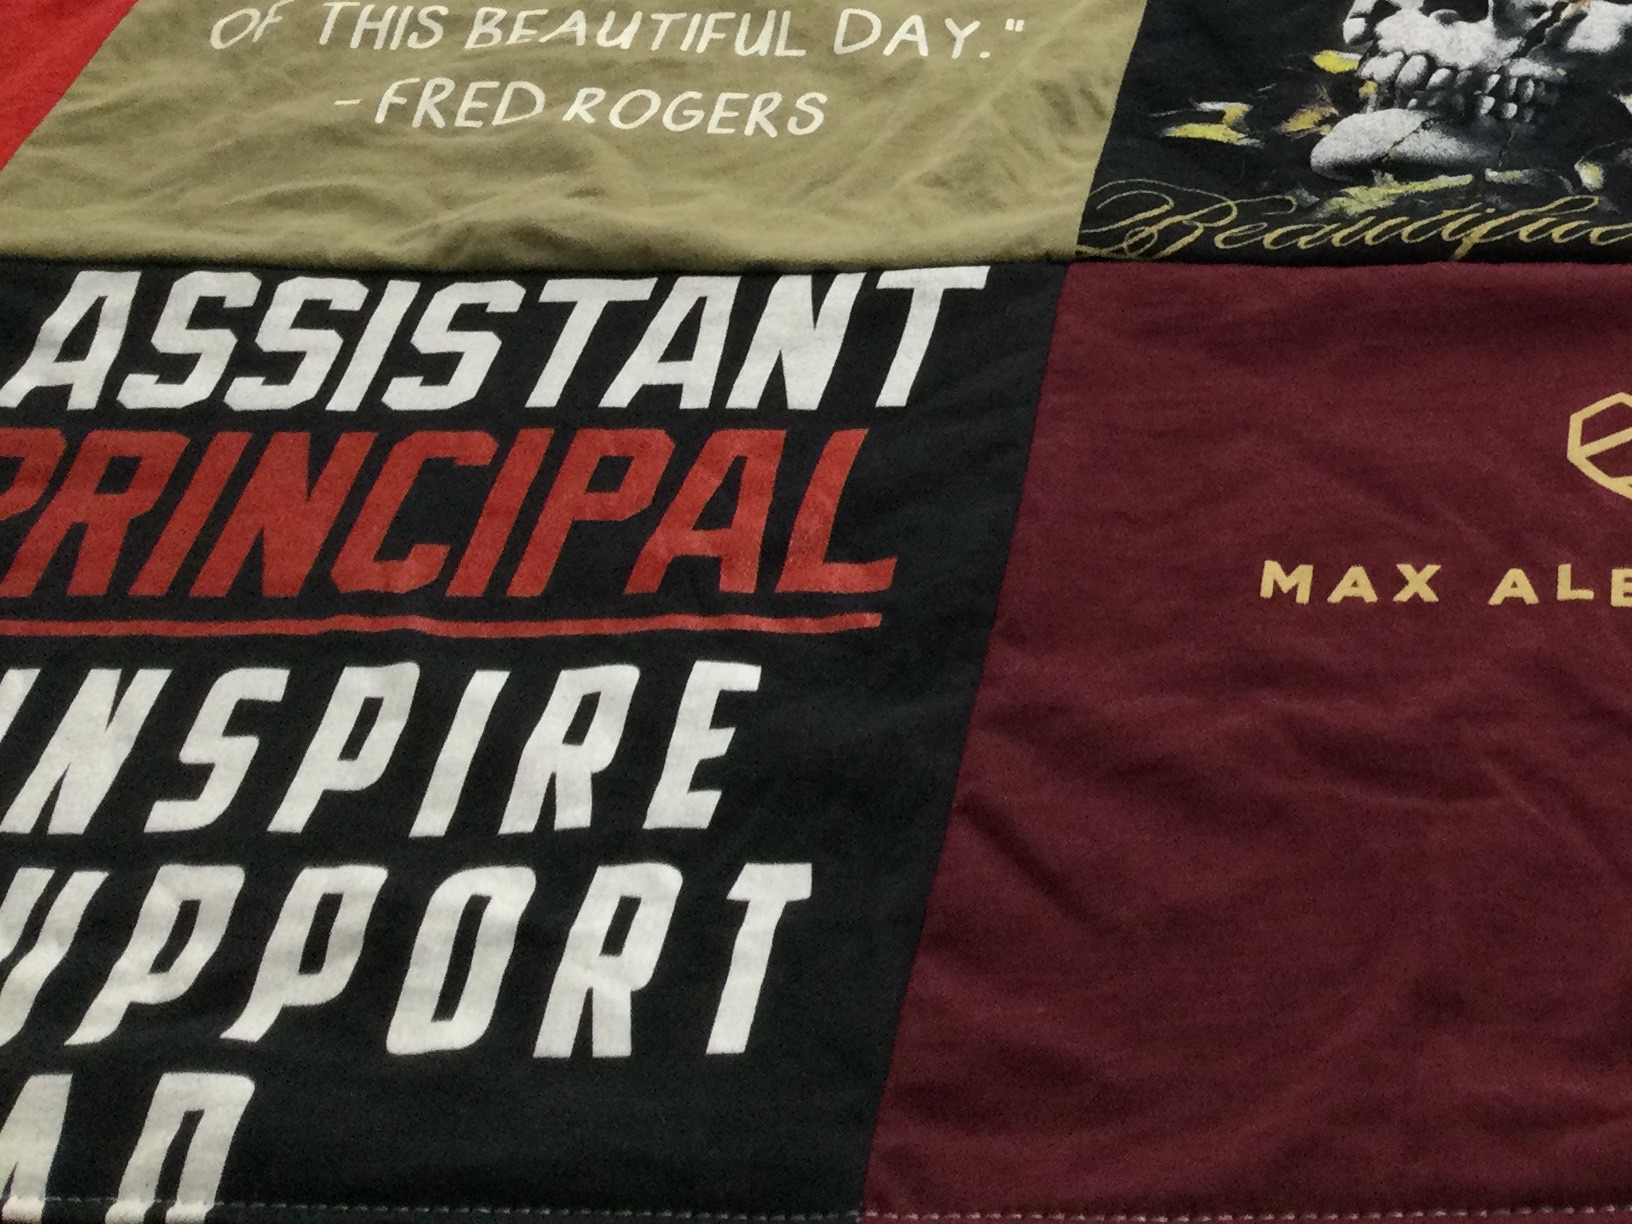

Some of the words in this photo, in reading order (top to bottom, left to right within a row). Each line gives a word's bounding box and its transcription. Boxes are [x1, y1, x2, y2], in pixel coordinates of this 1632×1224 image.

[317, 0, 450, 52] THIS
[464, 7, 808, 58] BEAUTIFUL
[561, 84, 829, 137] ROGERS
[0, 266, 991, 412] ASSISTANT
[0, 427, 899, 599] PRINCIPAL
[1258, 559, 1443, 605] MAX
